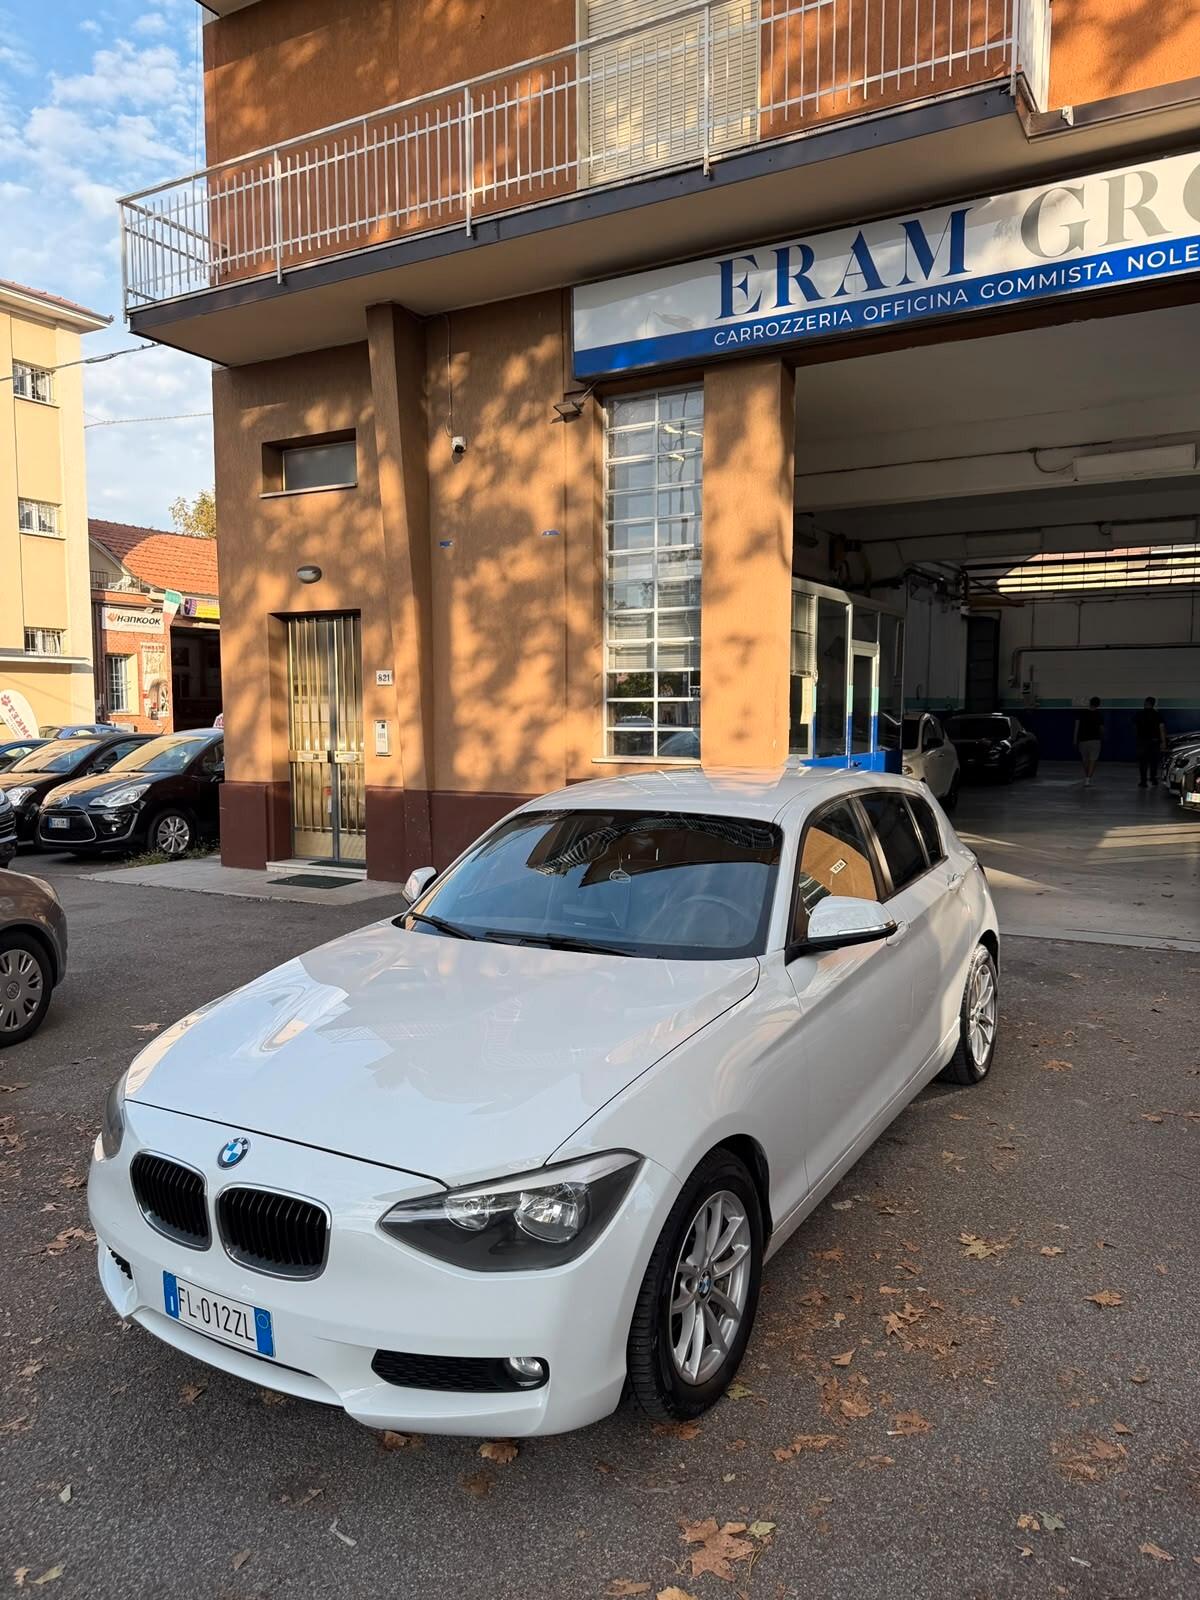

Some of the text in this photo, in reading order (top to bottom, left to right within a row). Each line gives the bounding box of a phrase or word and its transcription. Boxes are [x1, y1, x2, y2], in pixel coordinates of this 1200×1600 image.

[714, 207, 974, 320] ERAM
[714, 309, 853, 346] CARROZZERIA
[863, 288, 968, 321] OFFICINA
[979, 260, 1113, 299] GOMMISTA
